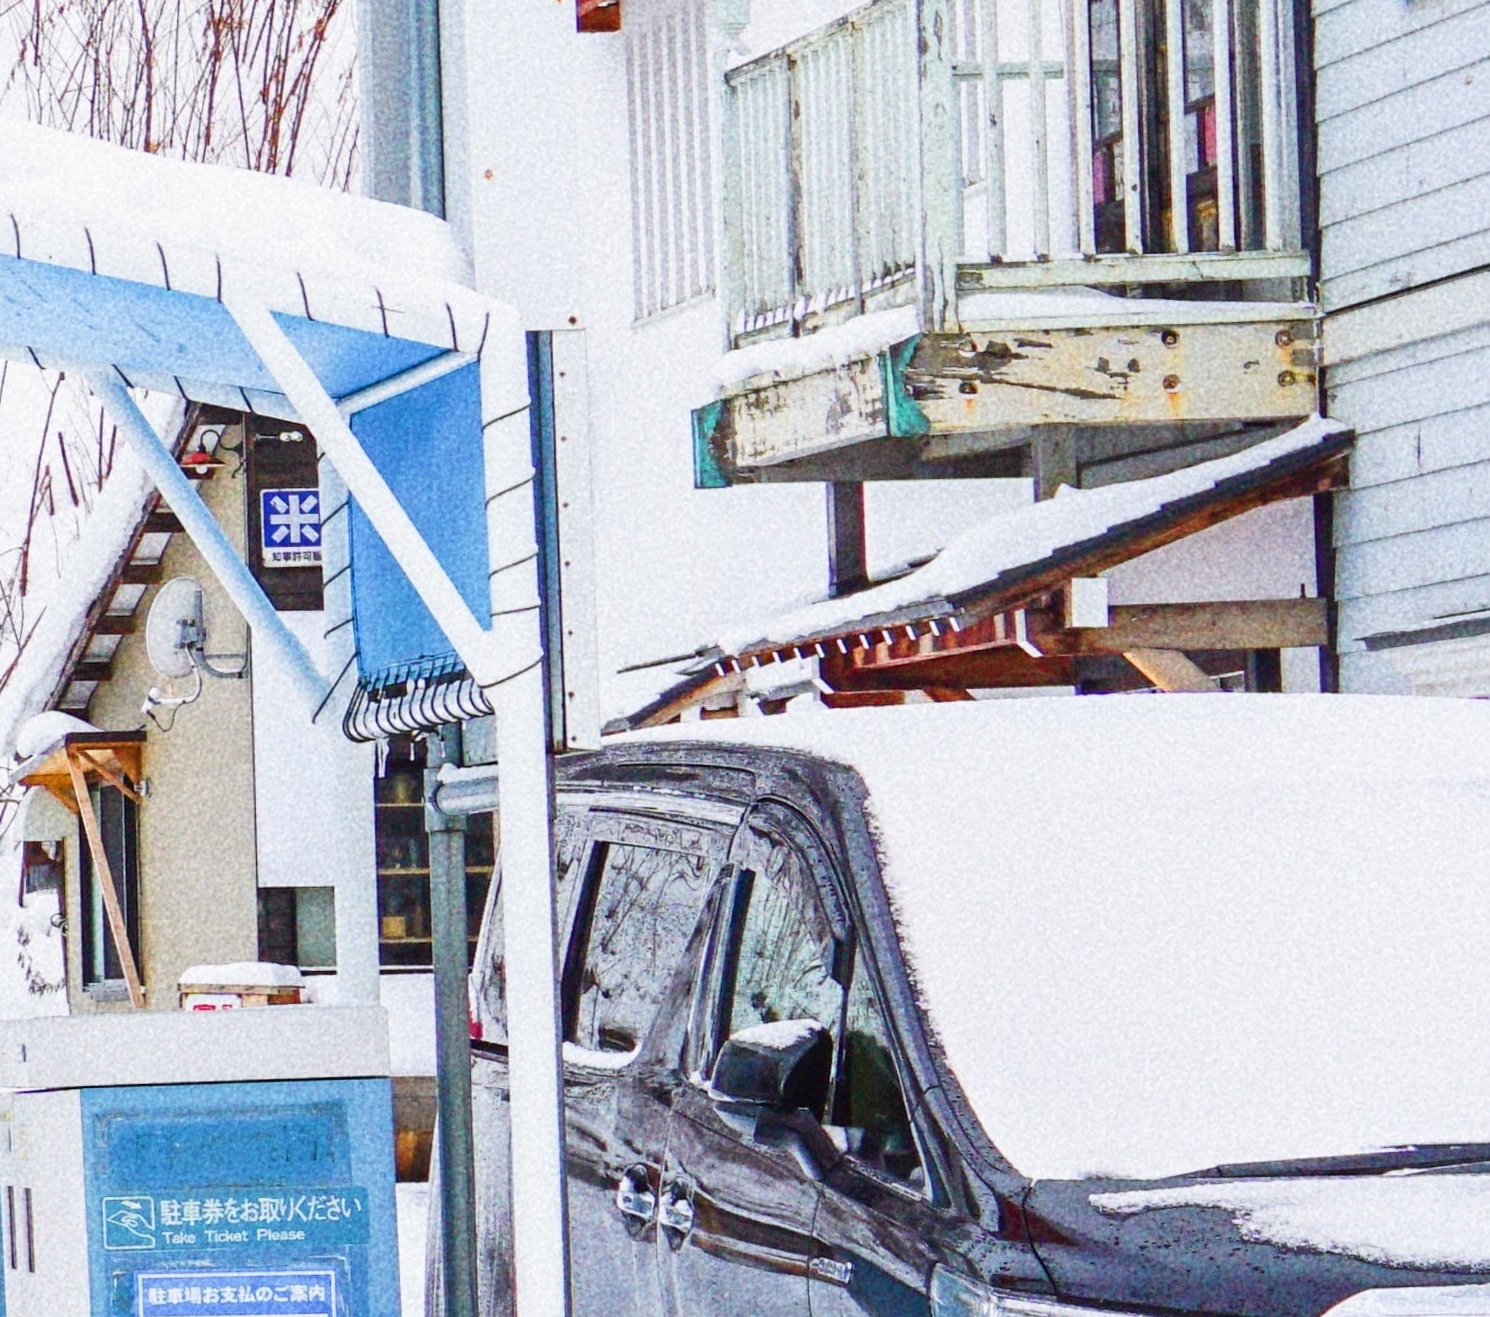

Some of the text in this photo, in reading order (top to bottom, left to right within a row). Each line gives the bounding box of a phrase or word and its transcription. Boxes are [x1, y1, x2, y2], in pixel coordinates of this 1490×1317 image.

[160, 1195, 362, 1227] 駐車券をお取りください
[161, 1229, 306, 1245] Take Ticket Please
[148, 1284, 327, 1305] 駐車場お支払のご案内
